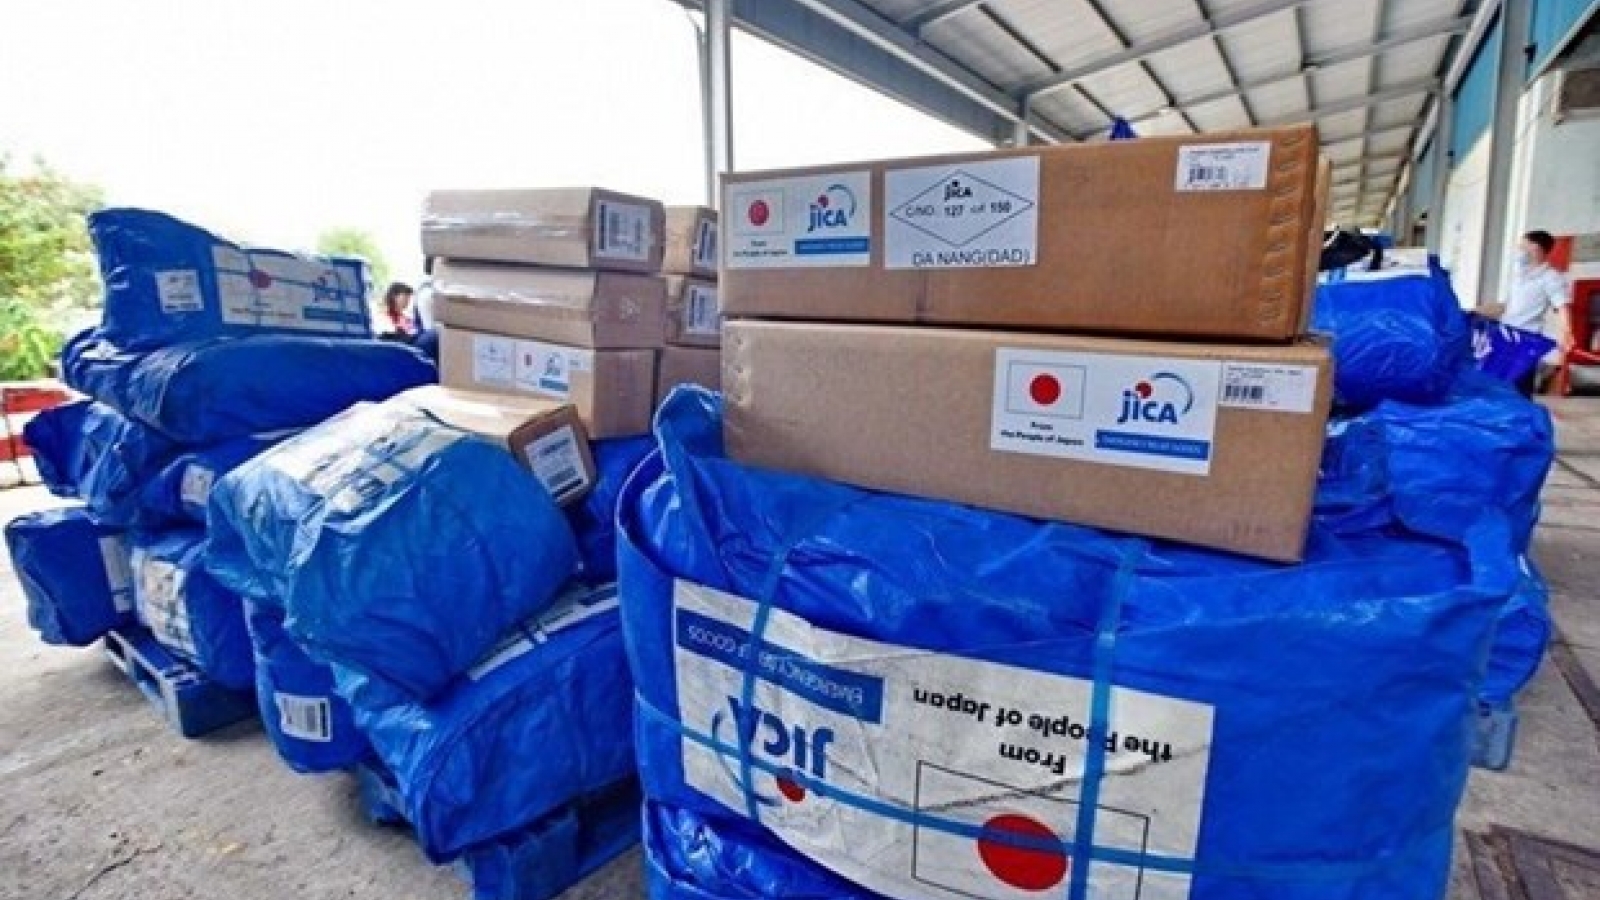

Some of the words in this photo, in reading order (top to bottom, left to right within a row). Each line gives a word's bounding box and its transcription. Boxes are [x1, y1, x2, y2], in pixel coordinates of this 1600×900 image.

[912, 252, 935, 266] DA
[1117, 388, 1178, 425] JICA
[912, 688, 992, 722] Japan
[995, 706, 1023, 728] of
[999, 742, 1067, 776] From
[1123, 735, 1173, 763] the
